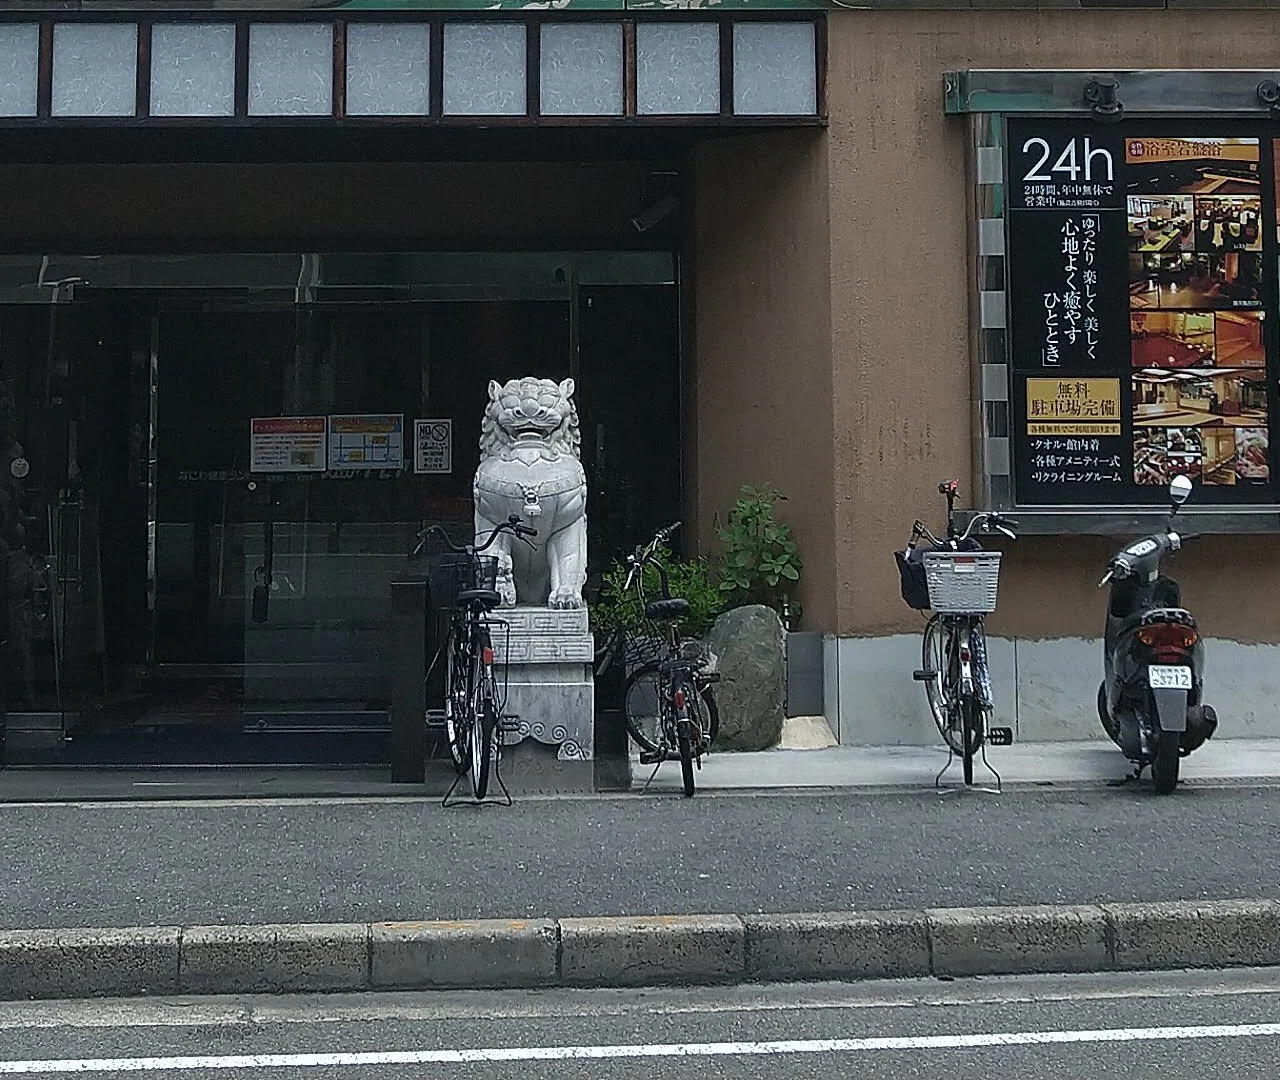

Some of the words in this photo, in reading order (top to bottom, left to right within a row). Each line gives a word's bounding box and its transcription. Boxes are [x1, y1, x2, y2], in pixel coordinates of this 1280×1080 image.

[1023, 137, 1114, 181] 24h
[1060, 218, 1082, 345] 心地よく癒やす
[1057, 382, 1090, 399] 無料
[1031, 399, 1115, 416] 駐車場完備
